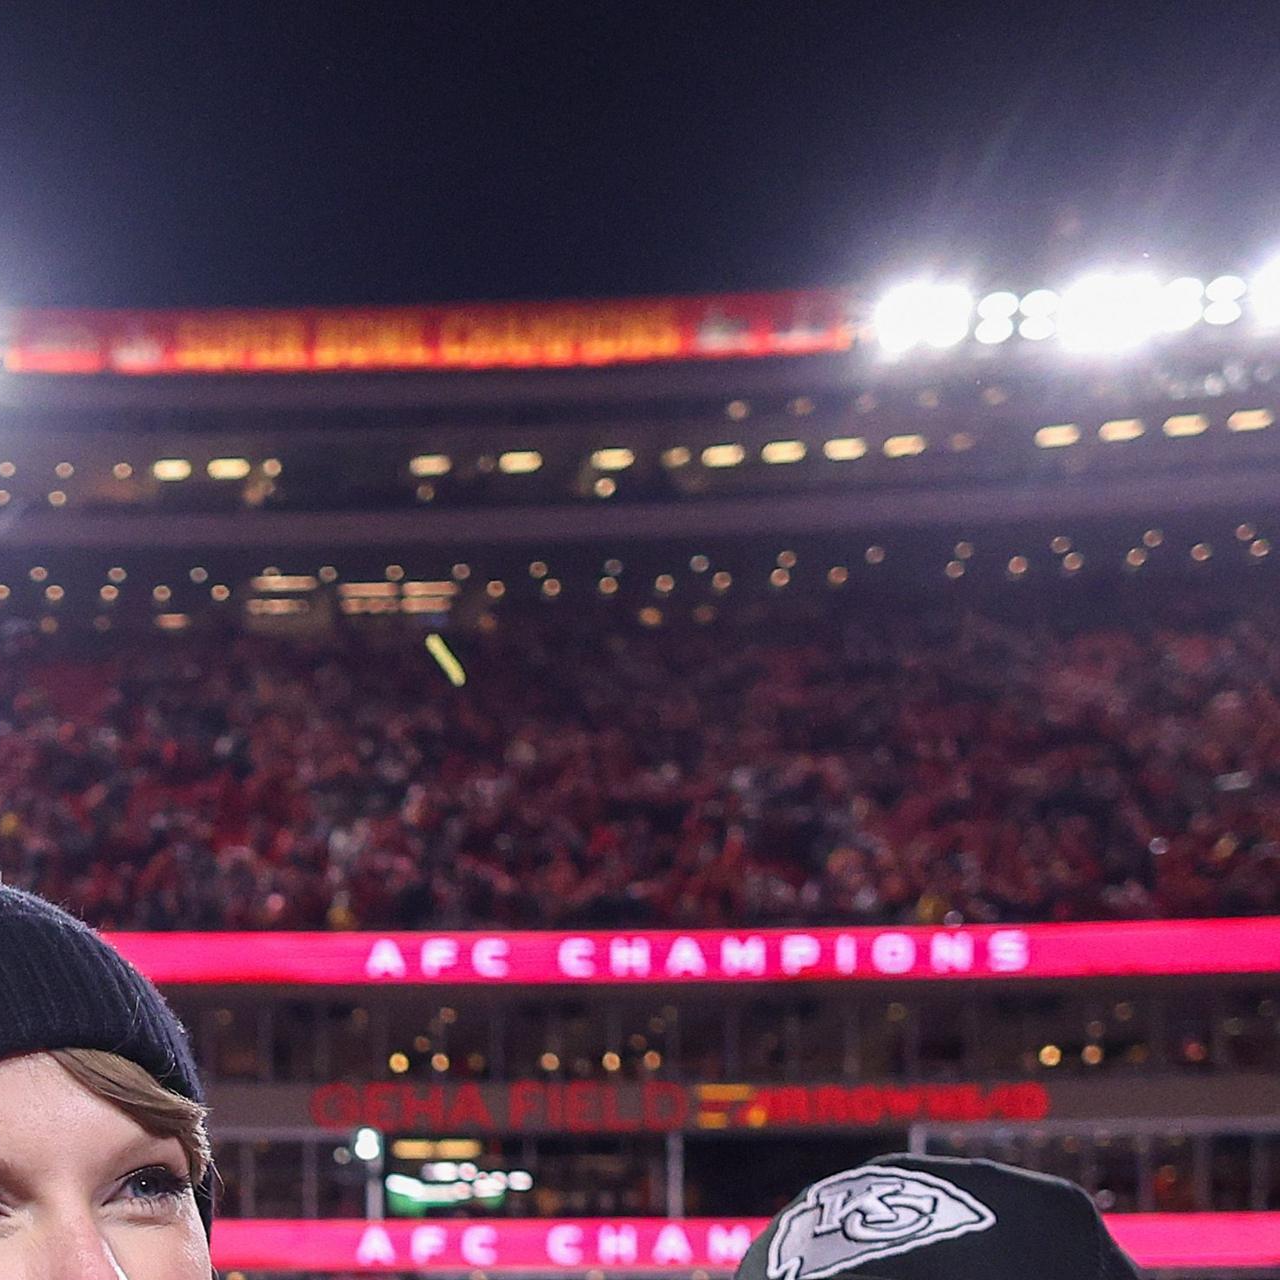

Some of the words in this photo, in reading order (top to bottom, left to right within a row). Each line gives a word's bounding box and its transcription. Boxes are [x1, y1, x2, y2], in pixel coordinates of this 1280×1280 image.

[366, 937, 510, 979] AFC
[557, 930, 1029, 979] CHAMPIONS
[509, 1080, 686, 1132] FIELD
[813, 1180, 940, 1243] KC
[355, 1224, 499, 1267] AFC
